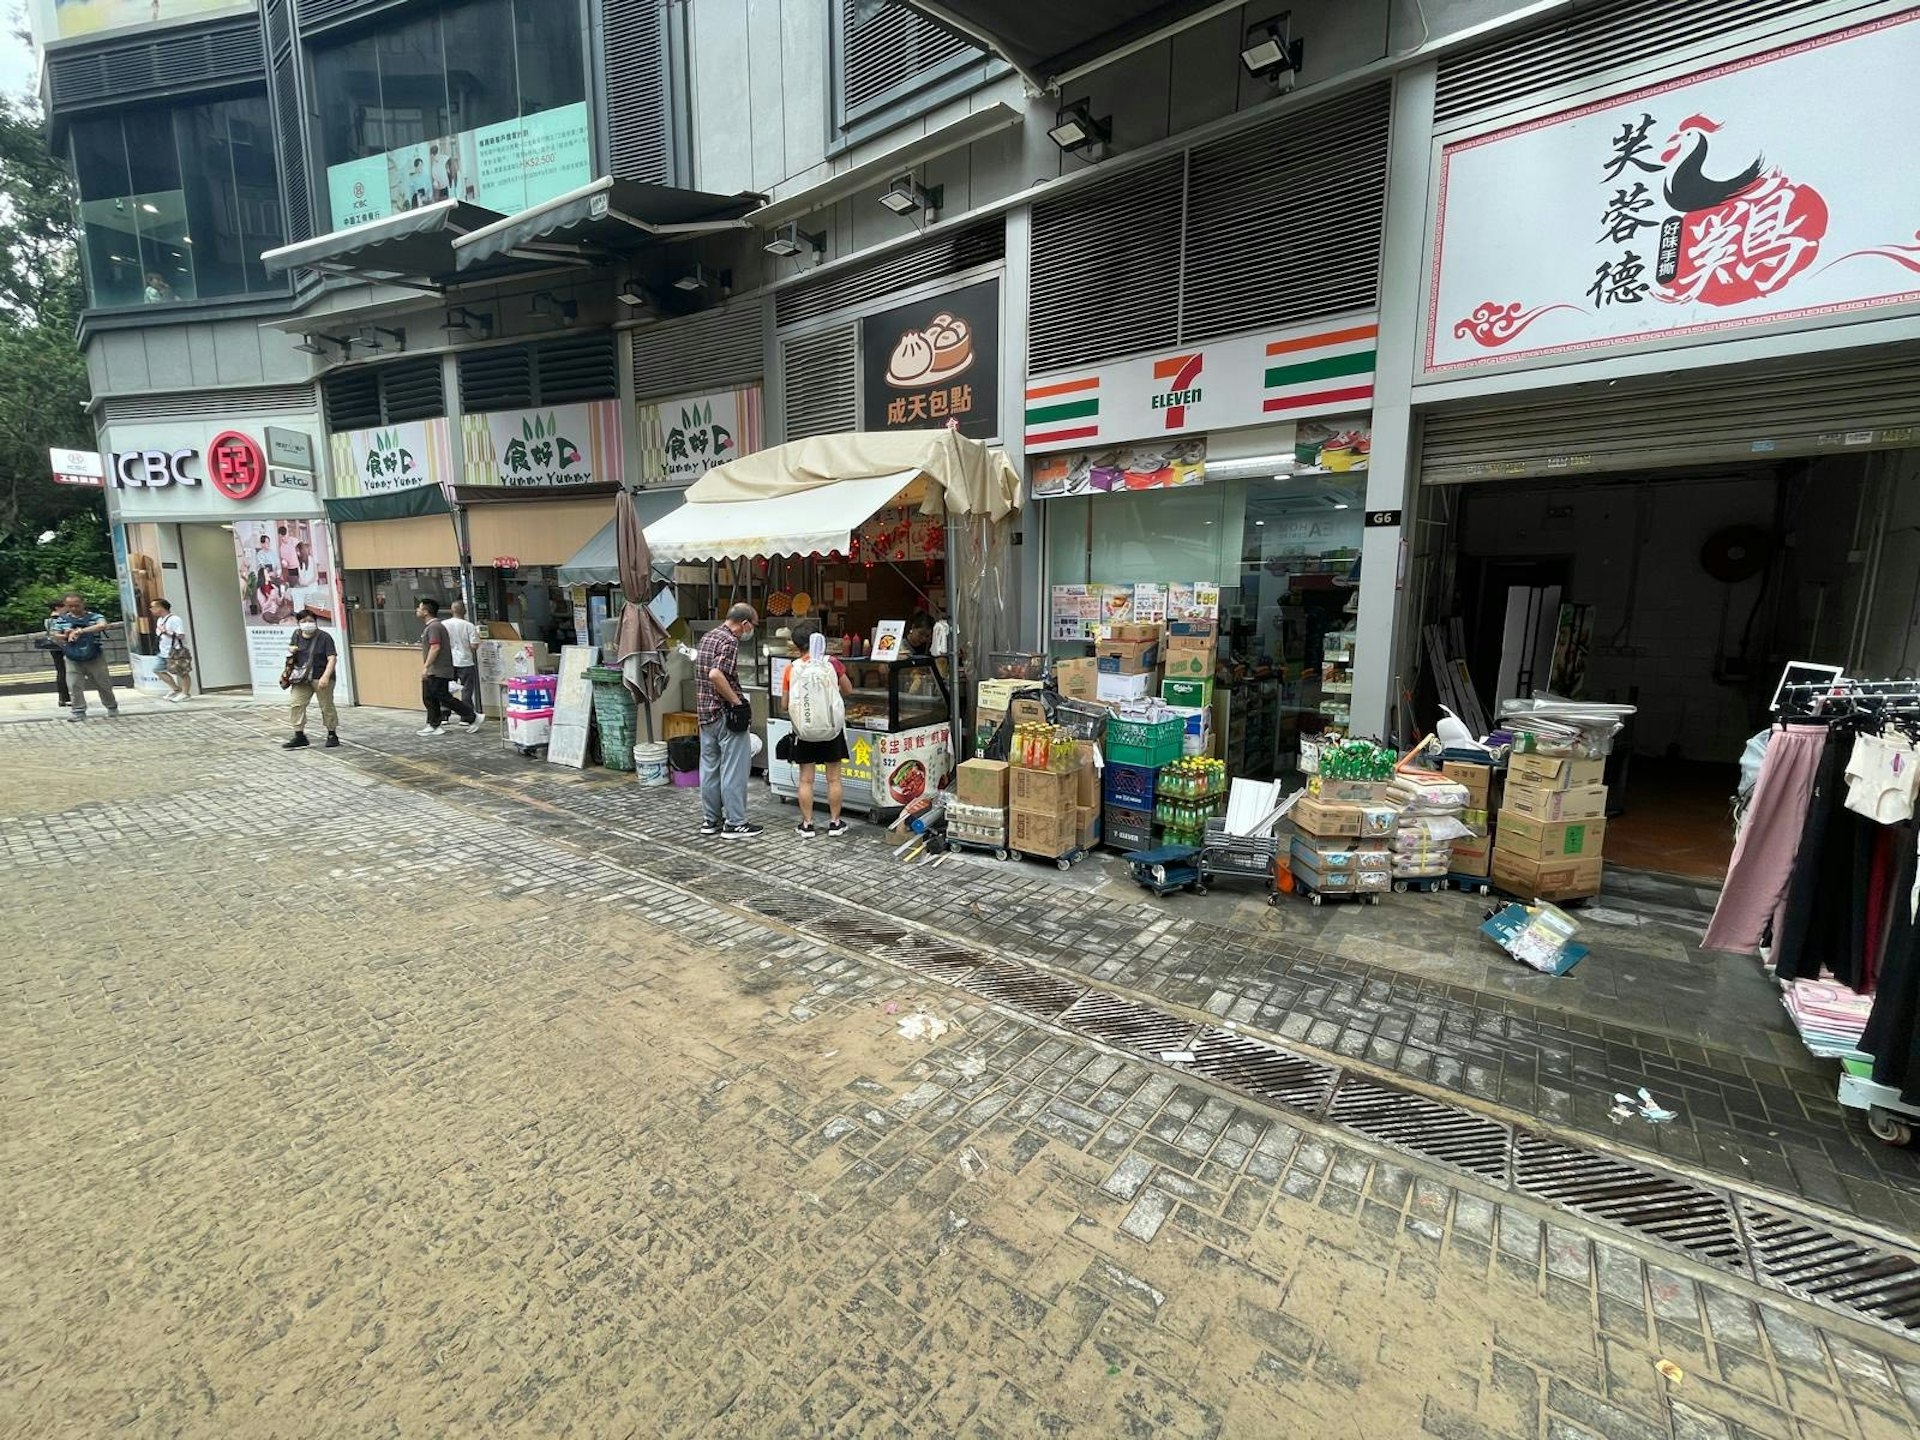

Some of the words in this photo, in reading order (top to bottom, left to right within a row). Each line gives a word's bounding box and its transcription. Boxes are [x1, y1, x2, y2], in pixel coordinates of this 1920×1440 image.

[1658, 221, 1680, 276] 好味手撕
[886, 384, 972, 426] 成天包點
[107, 449, 197, 488] ICBC
[661, 463, 699, 476] Yummy
[364, 479, 391, 490] Yummy
[394, 477, 423, 488] Yummy
[500, 474, 542, 486] Yummy
[546, 472, 592, 486] Yummy
[1373, 513, 1392, 524] G6
